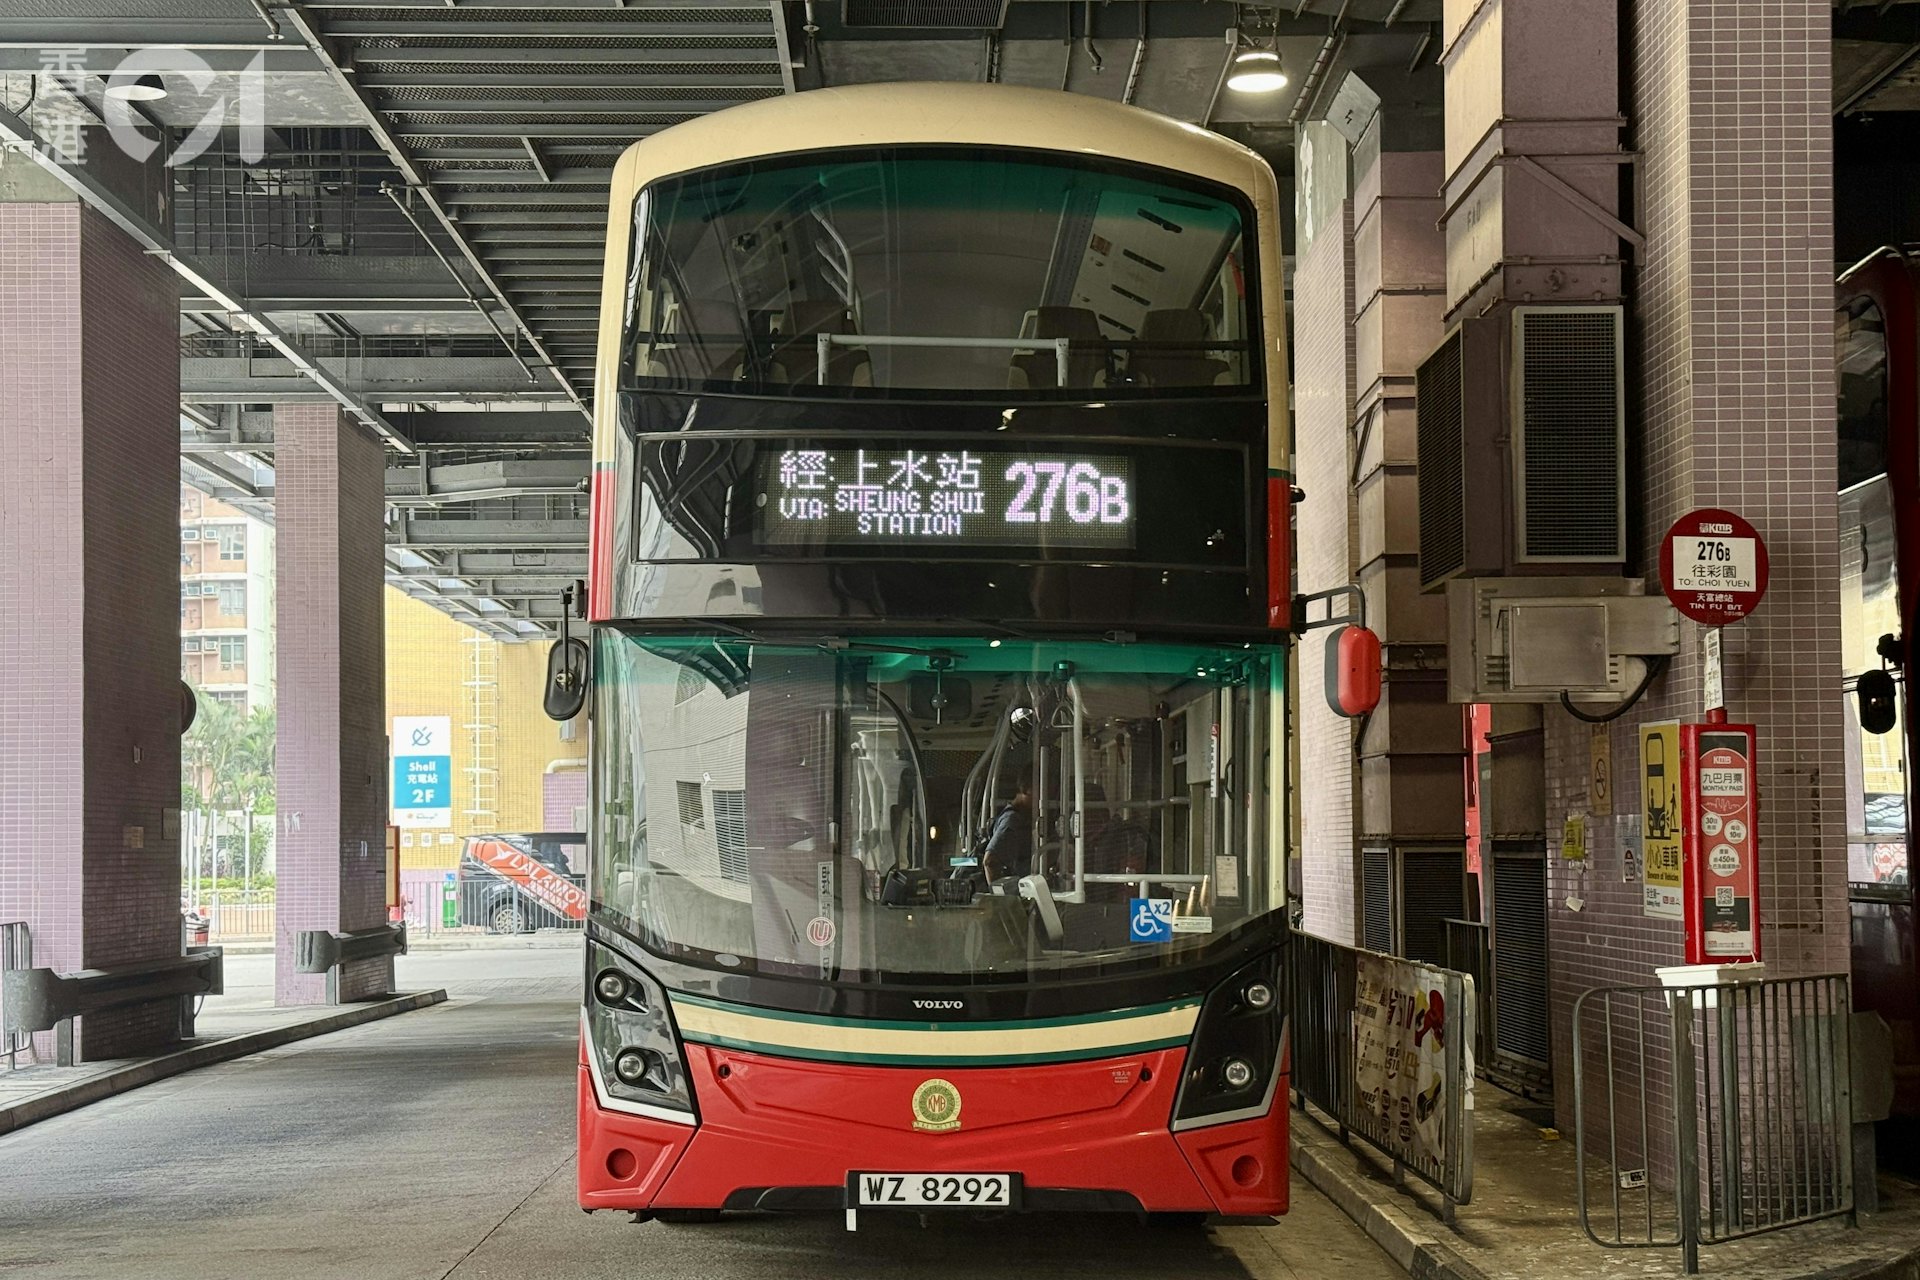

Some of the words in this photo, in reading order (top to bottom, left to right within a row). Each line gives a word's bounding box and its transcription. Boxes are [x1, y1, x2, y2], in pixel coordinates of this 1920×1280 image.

[1005, 462, 1128, 524] 276B
[779, 498, 829, 519] VIA:
[834, 490, 921, 513] SHEUNG
[930, 491, 985, 514] SHUI
[858, 513, 962, 535] STATION
[1709, 523, 1733, 534] KMB
[1697, 541, 1731, 561] 276B
[1692, 564, 1736, 578] 往彩園
[1678, 578, 1694, 586] TO:
[1698, 579, 1721, 587] CHOI
[1725, 580, 1750, 588] YUEN
[1697, 592, 1734, 602] 天富總站
[409, 761, 436, 772] Shell
[407, 774, 438, 785] 充電站
[1703, 772, 1743, 784] 九巴月票
[412, 788, 435, 804] 2F
[1154, 901, 1171, 916] x2
[912, 1000, 964, 1009] VOLVO
[867, 1177, 906, 1202] WZ
[921, 1177, 1003, 1202] 8292
